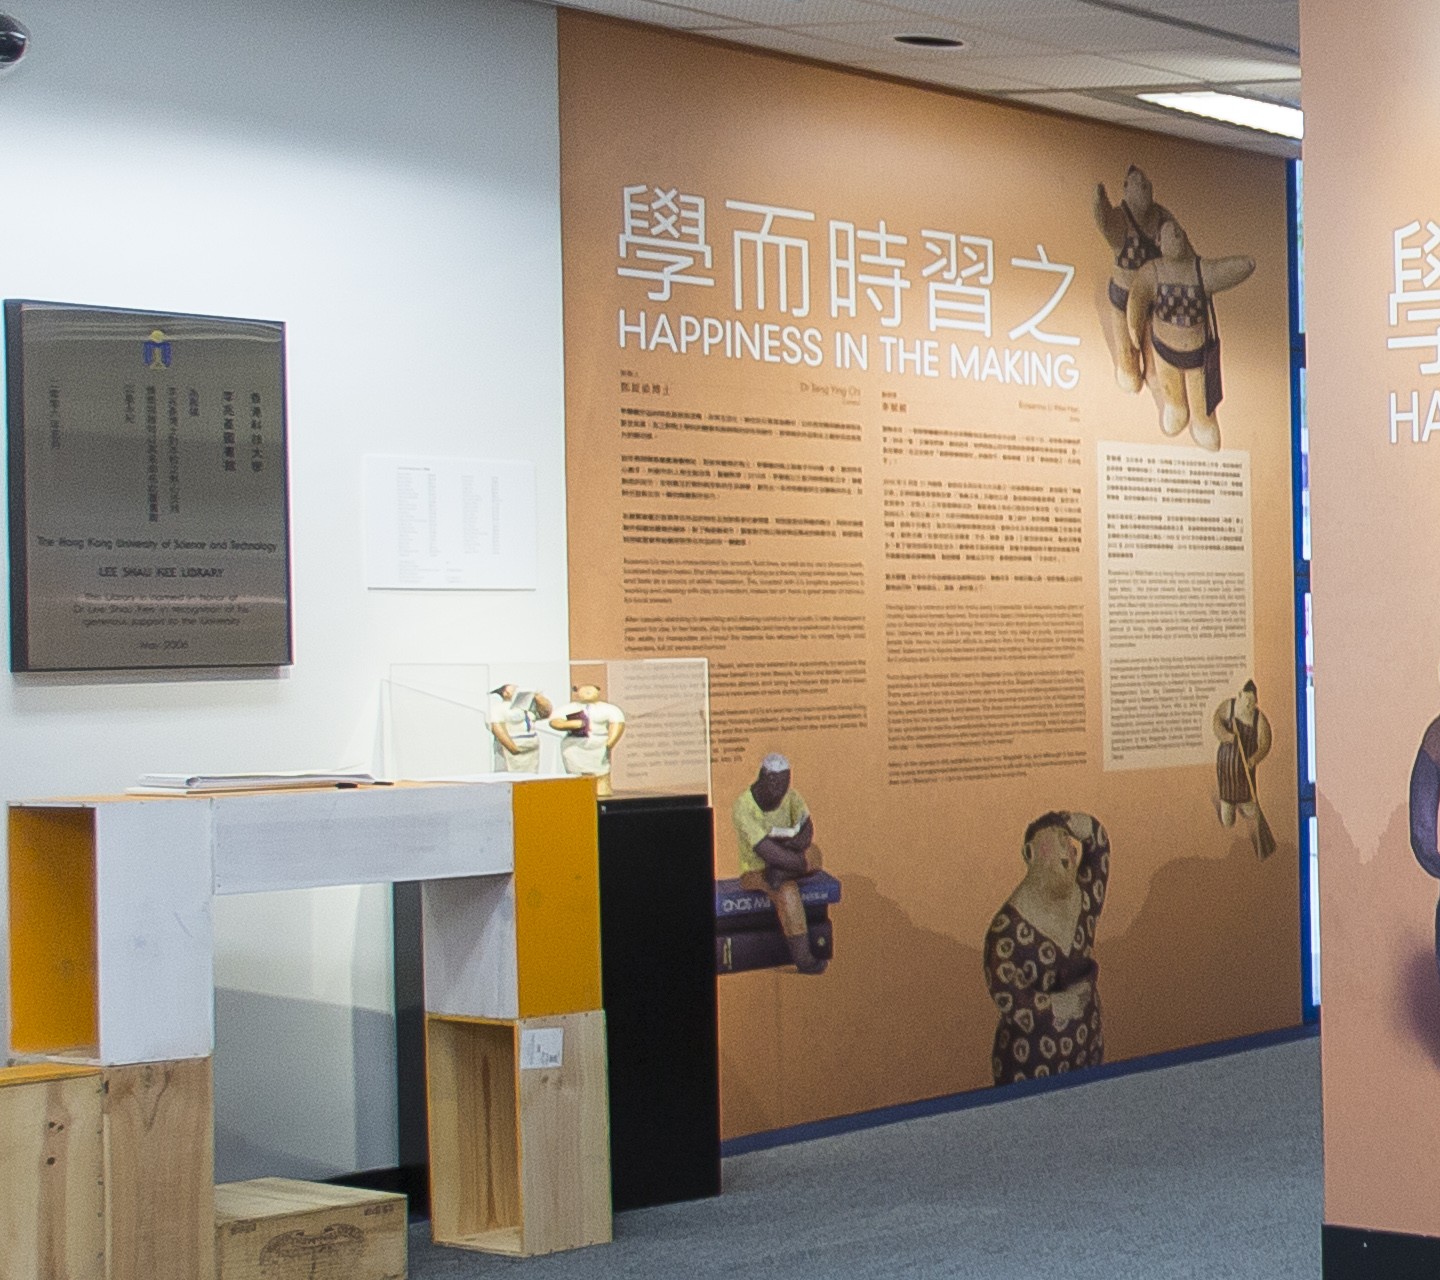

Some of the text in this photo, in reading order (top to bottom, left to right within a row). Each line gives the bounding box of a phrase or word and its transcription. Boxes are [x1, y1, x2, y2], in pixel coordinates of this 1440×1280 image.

[617, 184, 1082, 348] 學而時習之
[618, 308, 1081, 391] HAPPINESS IN THE MAKING
